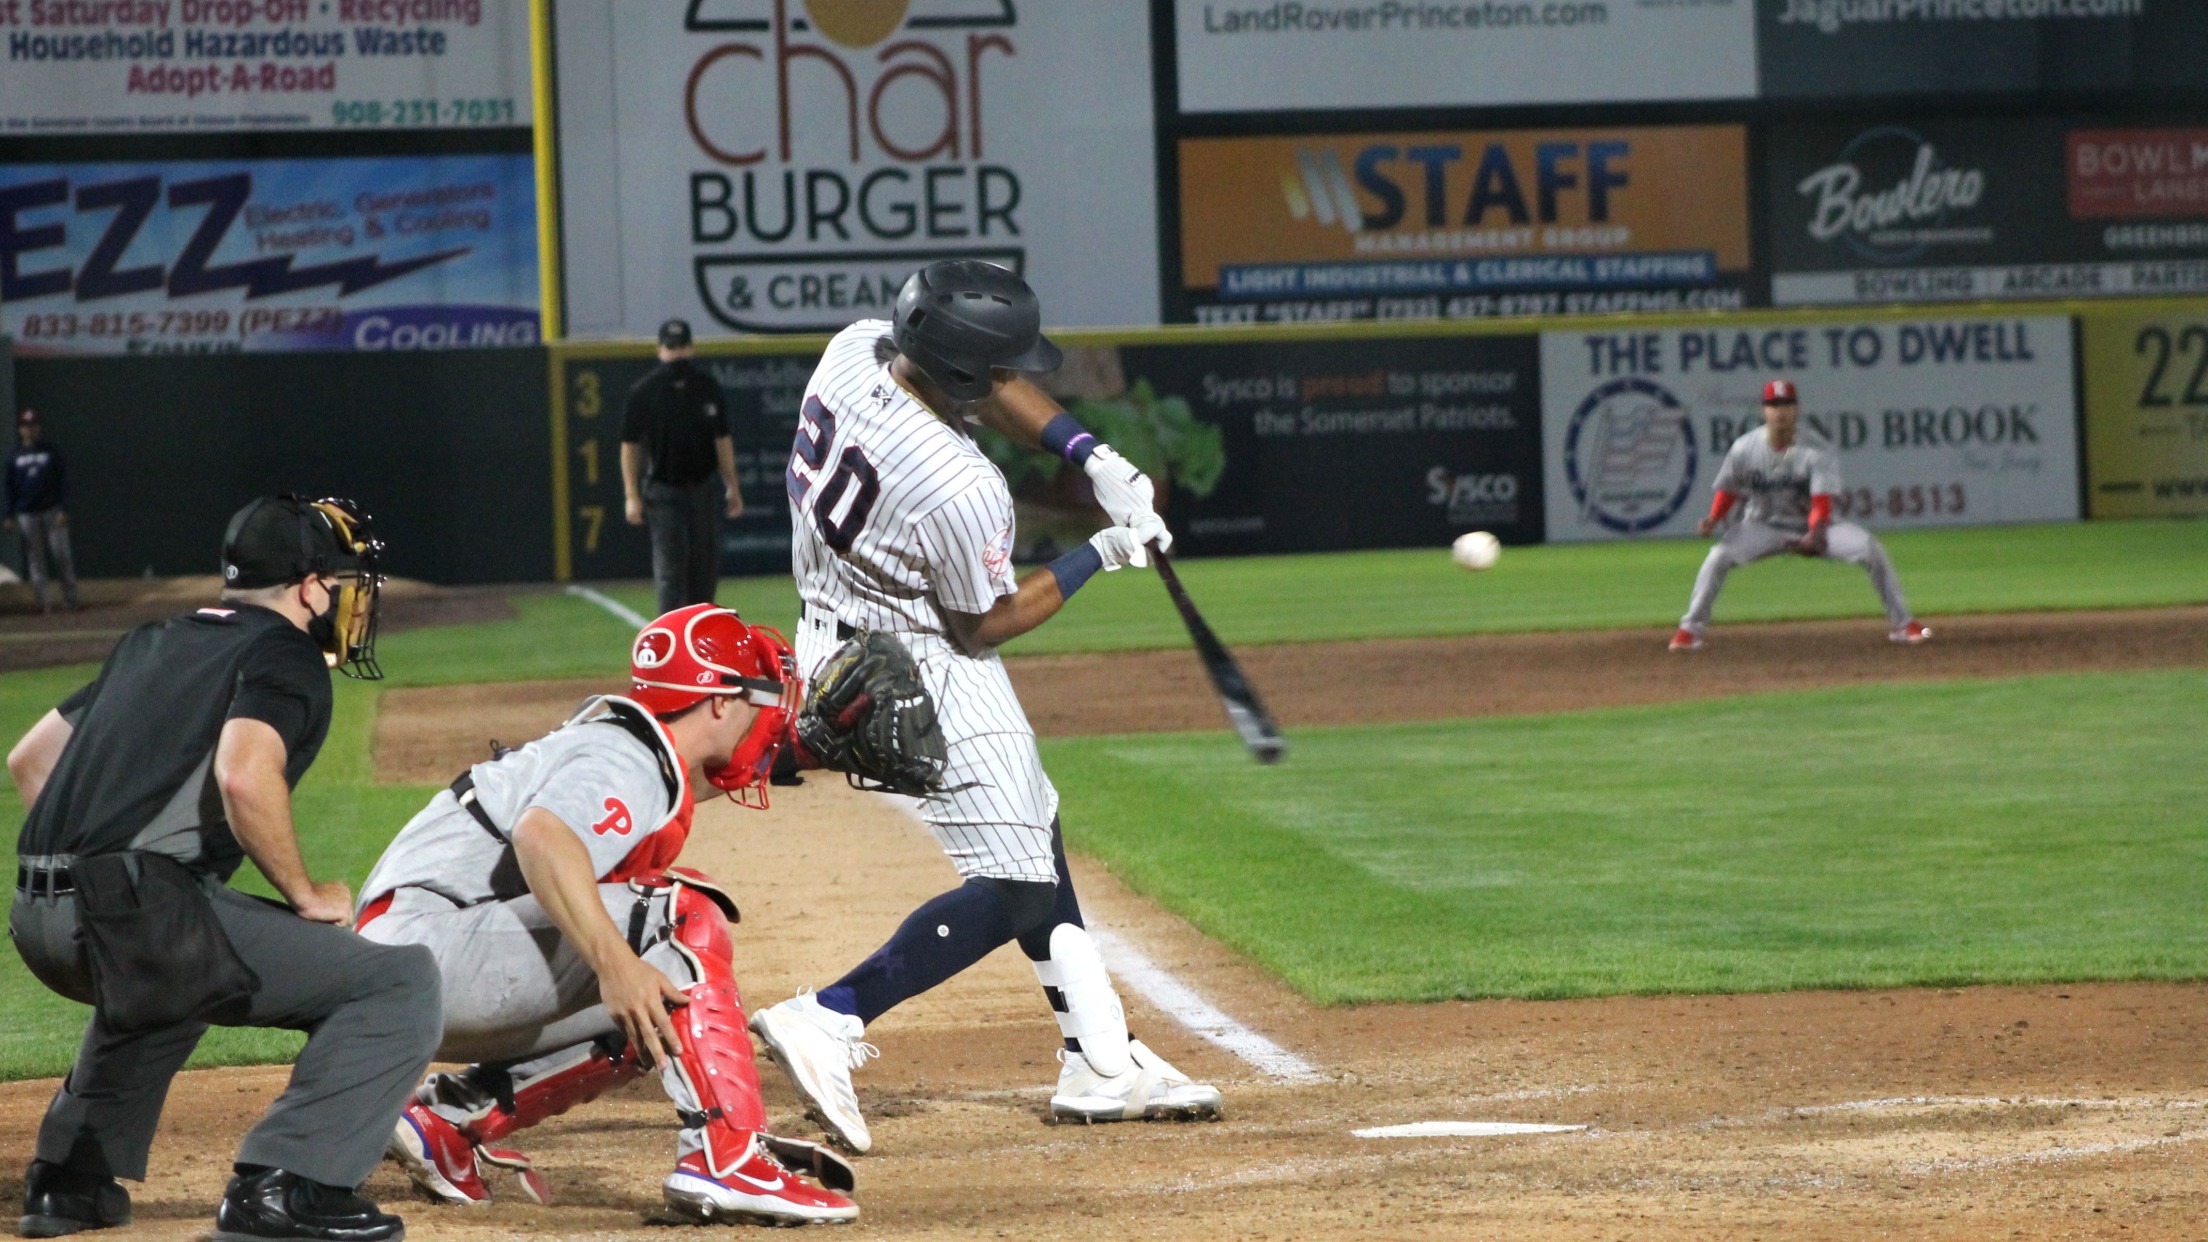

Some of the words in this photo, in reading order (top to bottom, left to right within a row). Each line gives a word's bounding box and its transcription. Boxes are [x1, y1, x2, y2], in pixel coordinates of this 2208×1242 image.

[31, 0, 170, 29] Saturday
[182, 0, 308, 26] Drop-Off
[339, 0, 482, 26] Recycling
[1204, 2, 1608, 33] LandRoverPrinceton.com
[9, 31, 174, 60] Household
[185, 30, 345, 57] Hazardous
[355, 28, 446, 55] Waste
[127, 63, 336, 98] Adopt-A-Road
[683, 0, 1016, 165] char
[332, 100, 515, 125] 908-231-7031
[1353, 140, 1631, 230] STAFF
[1797, 143, 1985, 241] Bowlero
[689, 167, 1021, 244] BURGER
[256, 225, 353, 254] Heating
[394, 207, 491, 236] Cooling
[1354, 229, 1533, 252] MANAGEMENT
[1542, 225, 1630, 247] GROUP
[727, 274, 755, 310] &
[767, 273, 912, 309] CREAM
[1226, 267, 1297, 293] LIGHT
[1303, 262, 1447, 288] INDUSTRIAL
[1453, 260, 1471, 284] &
[1475, 258, 1588, 282] CLERICAL
[1594, 253, 1708, 278] STAFFING
[1852, 274, 1973, 297] BOWLING
[2002, 269, 2104, 293] ARCADE
[23, 309, 231, 338] 833-815-7399
[1195, 305, 1256, 326] TEXT
[1584, 333, 1660, 376] THE
[1679, 327, 1807, 373] PLACE
[1822, 325, 1882, 368] TO
[1898, 320, 2035, 365] DWELL
[1203, 371, 1274, 407] Sysco
[1277, 374, 1296, 397] is
[1389, 372, 1415, 396] to
[1420, 371, 1517, 399] sponsor
[1254, 409, 1294, 436] the
[1302, 405, 1415, 435] Somerset
[1419, 401, 1519, 431] Patriots.
[1881, 402, 2041, 448] BROOK
[786, 394, 880, 556] 20
[1426, 465, 1519, 507] Sysco
[592, 795, 633, 837] P
